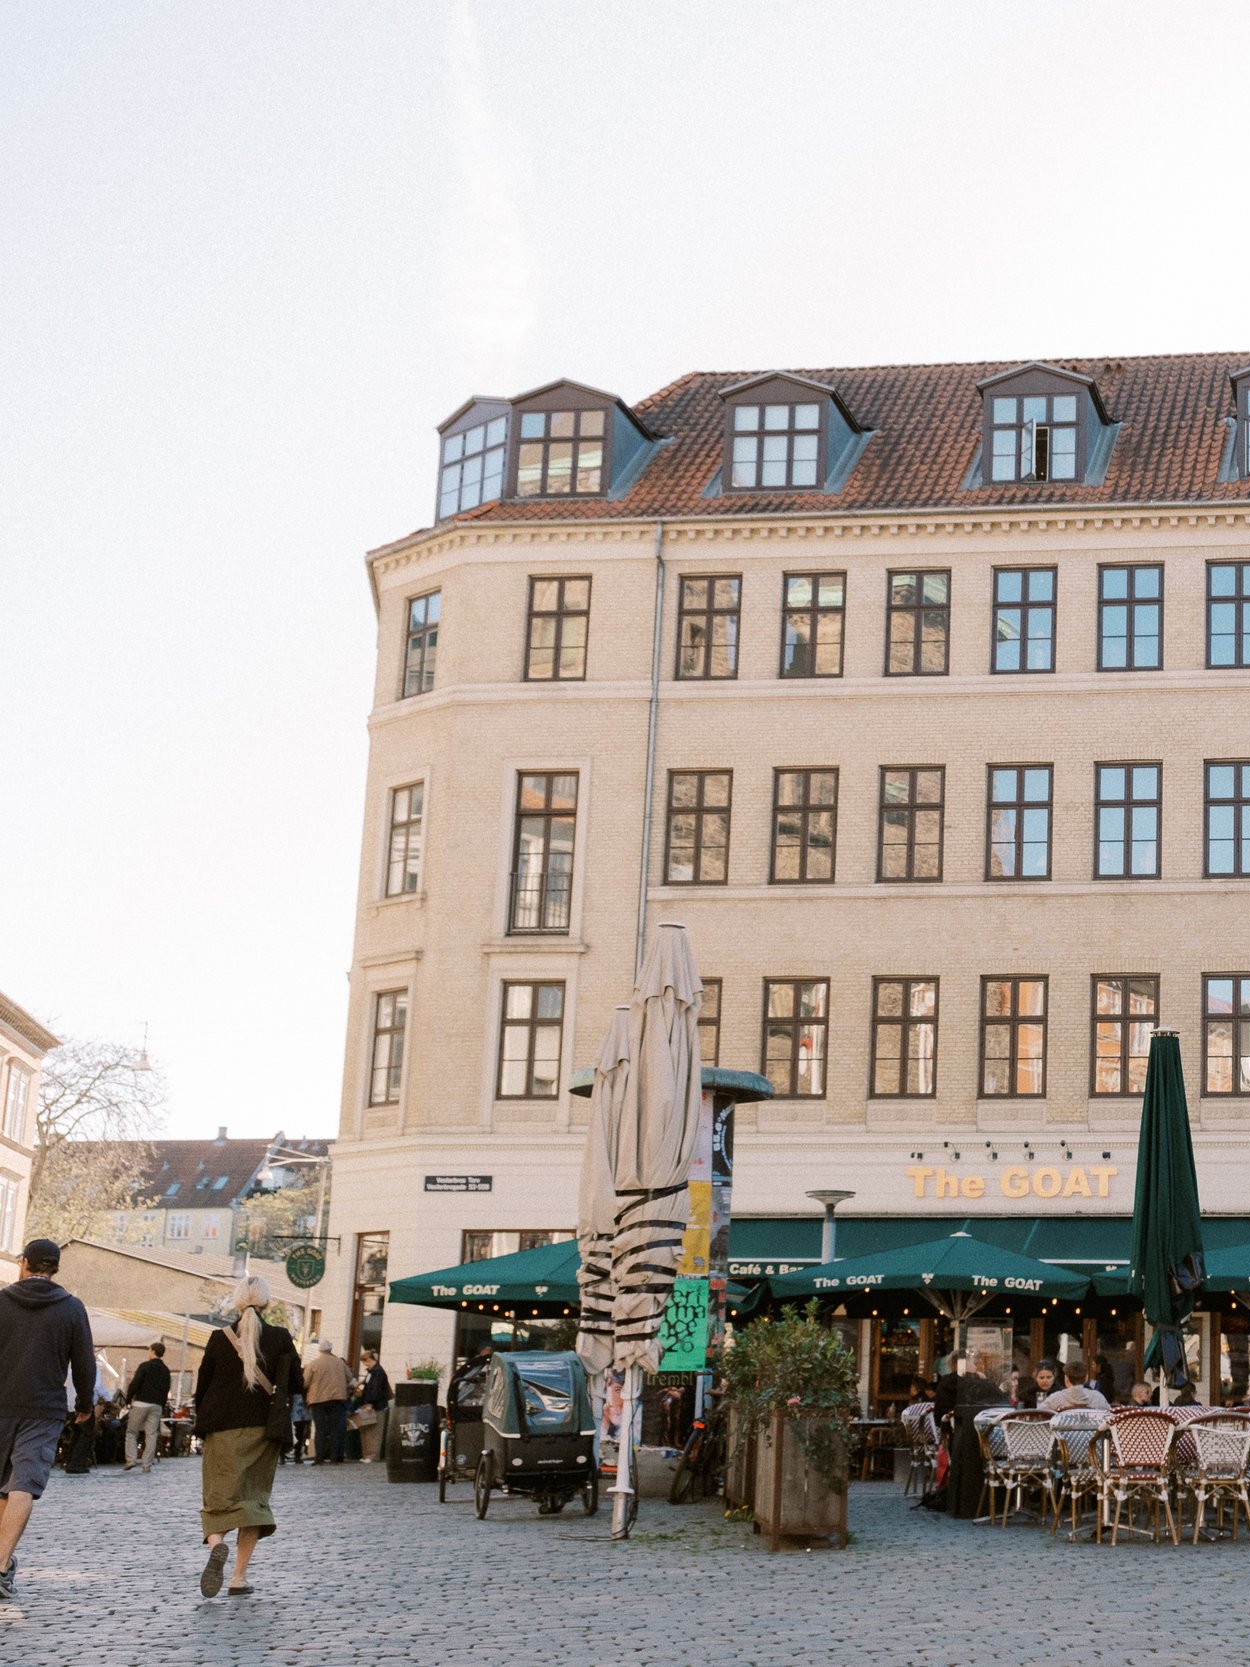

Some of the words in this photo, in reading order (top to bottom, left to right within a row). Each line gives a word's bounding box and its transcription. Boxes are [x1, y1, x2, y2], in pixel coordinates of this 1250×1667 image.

[904, 1167, 985, 1198] The
[1001, 1167, 1118, 1198] GOAT
[729, 1263, 761, 1275] Café
[765, 1264, 774, 1275] &
[813, 1278, 840, 1288] The
[846, 1274, 884, 1285] GOAT
[972, 1275, 998, 1287] The
[1004, 1276, 1043, 1291] GOAT
[431, 1285, 457, 1297] The
[462, 1284, 500, 1295] GOAT
